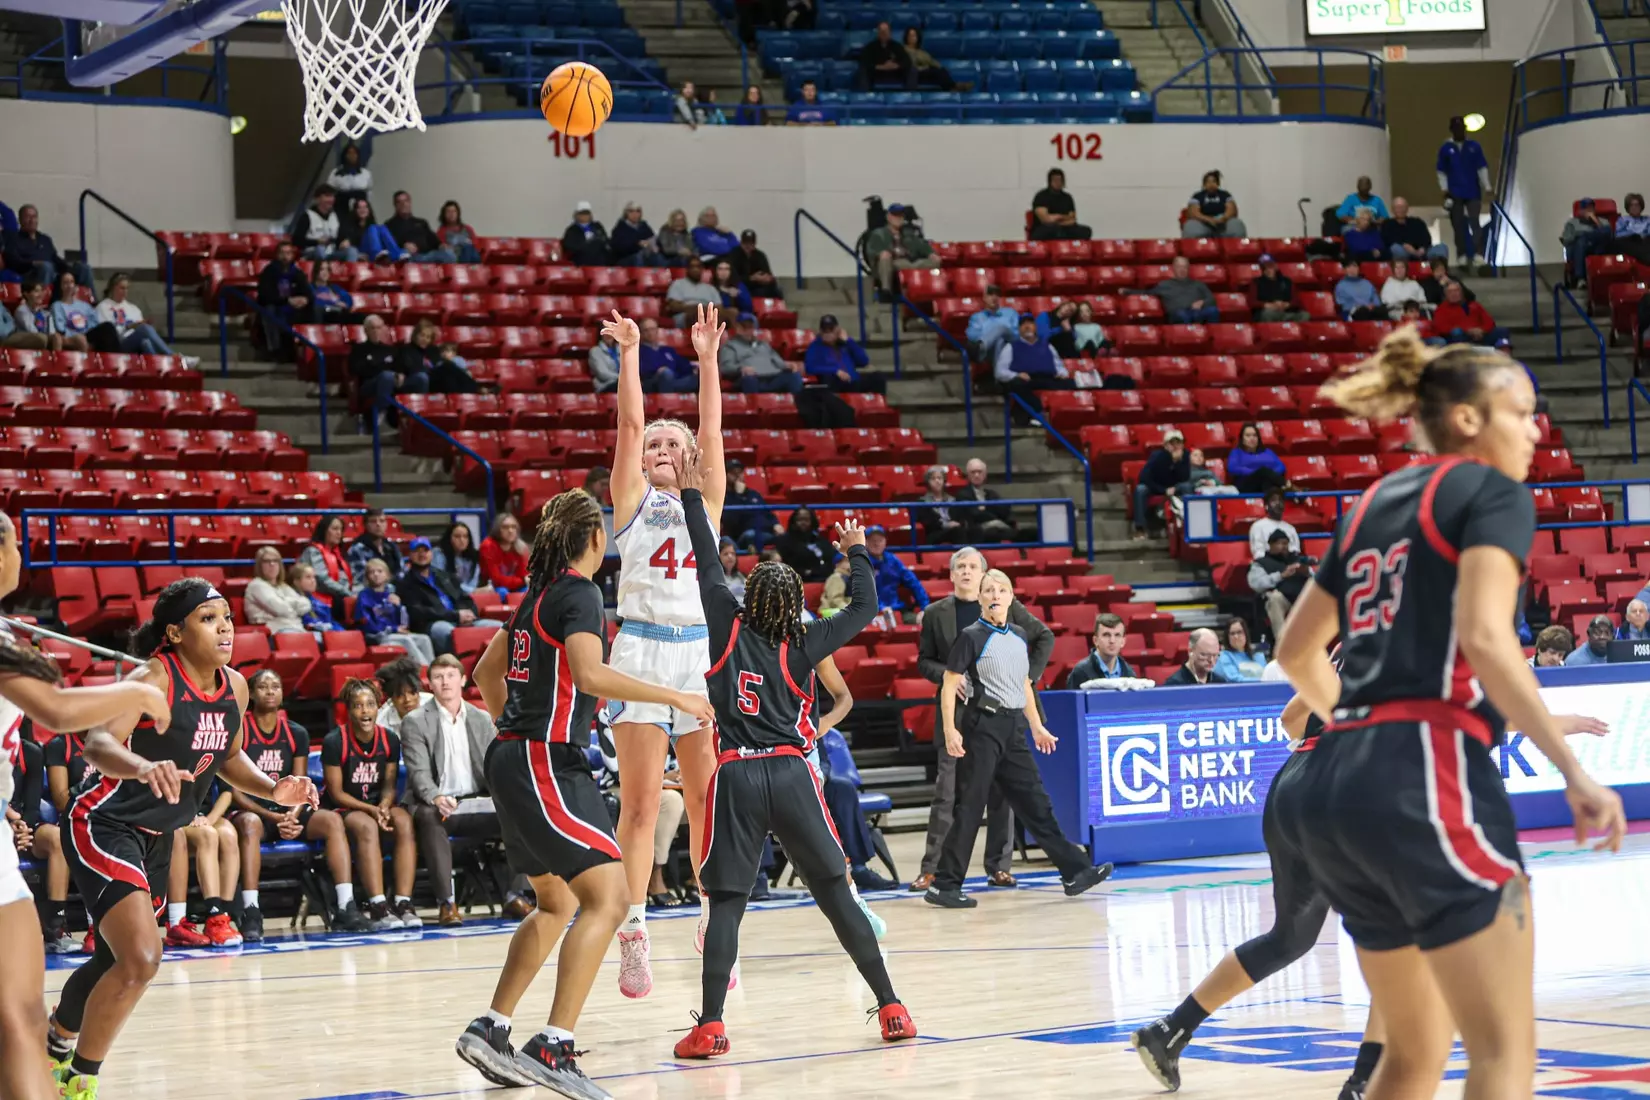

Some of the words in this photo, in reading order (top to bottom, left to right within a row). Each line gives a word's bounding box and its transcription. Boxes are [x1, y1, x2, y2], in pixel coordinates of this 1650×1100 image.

[1317, 0, 1382, 21] Super
[1407, 0, 1473, 13] Foods
[547, 129, 595, 159] 101
[1050, 132, 1103, 160] 102
[1345, 538, 1412, 638] 23
[737, 669, 763, 715] 5
[197, 712, 226, 731] JAX
[191, 731, 229, 751] STATE
[256, 760, 284, 771] STATE
[259, 749, 282, 761] JAX
[1179, 750, 1255, 779] NEXT
[351, 772, 379, 783] STATE
[355, 761, 378, 773] JAX
[1181, 780, 1256, 810] BANK
